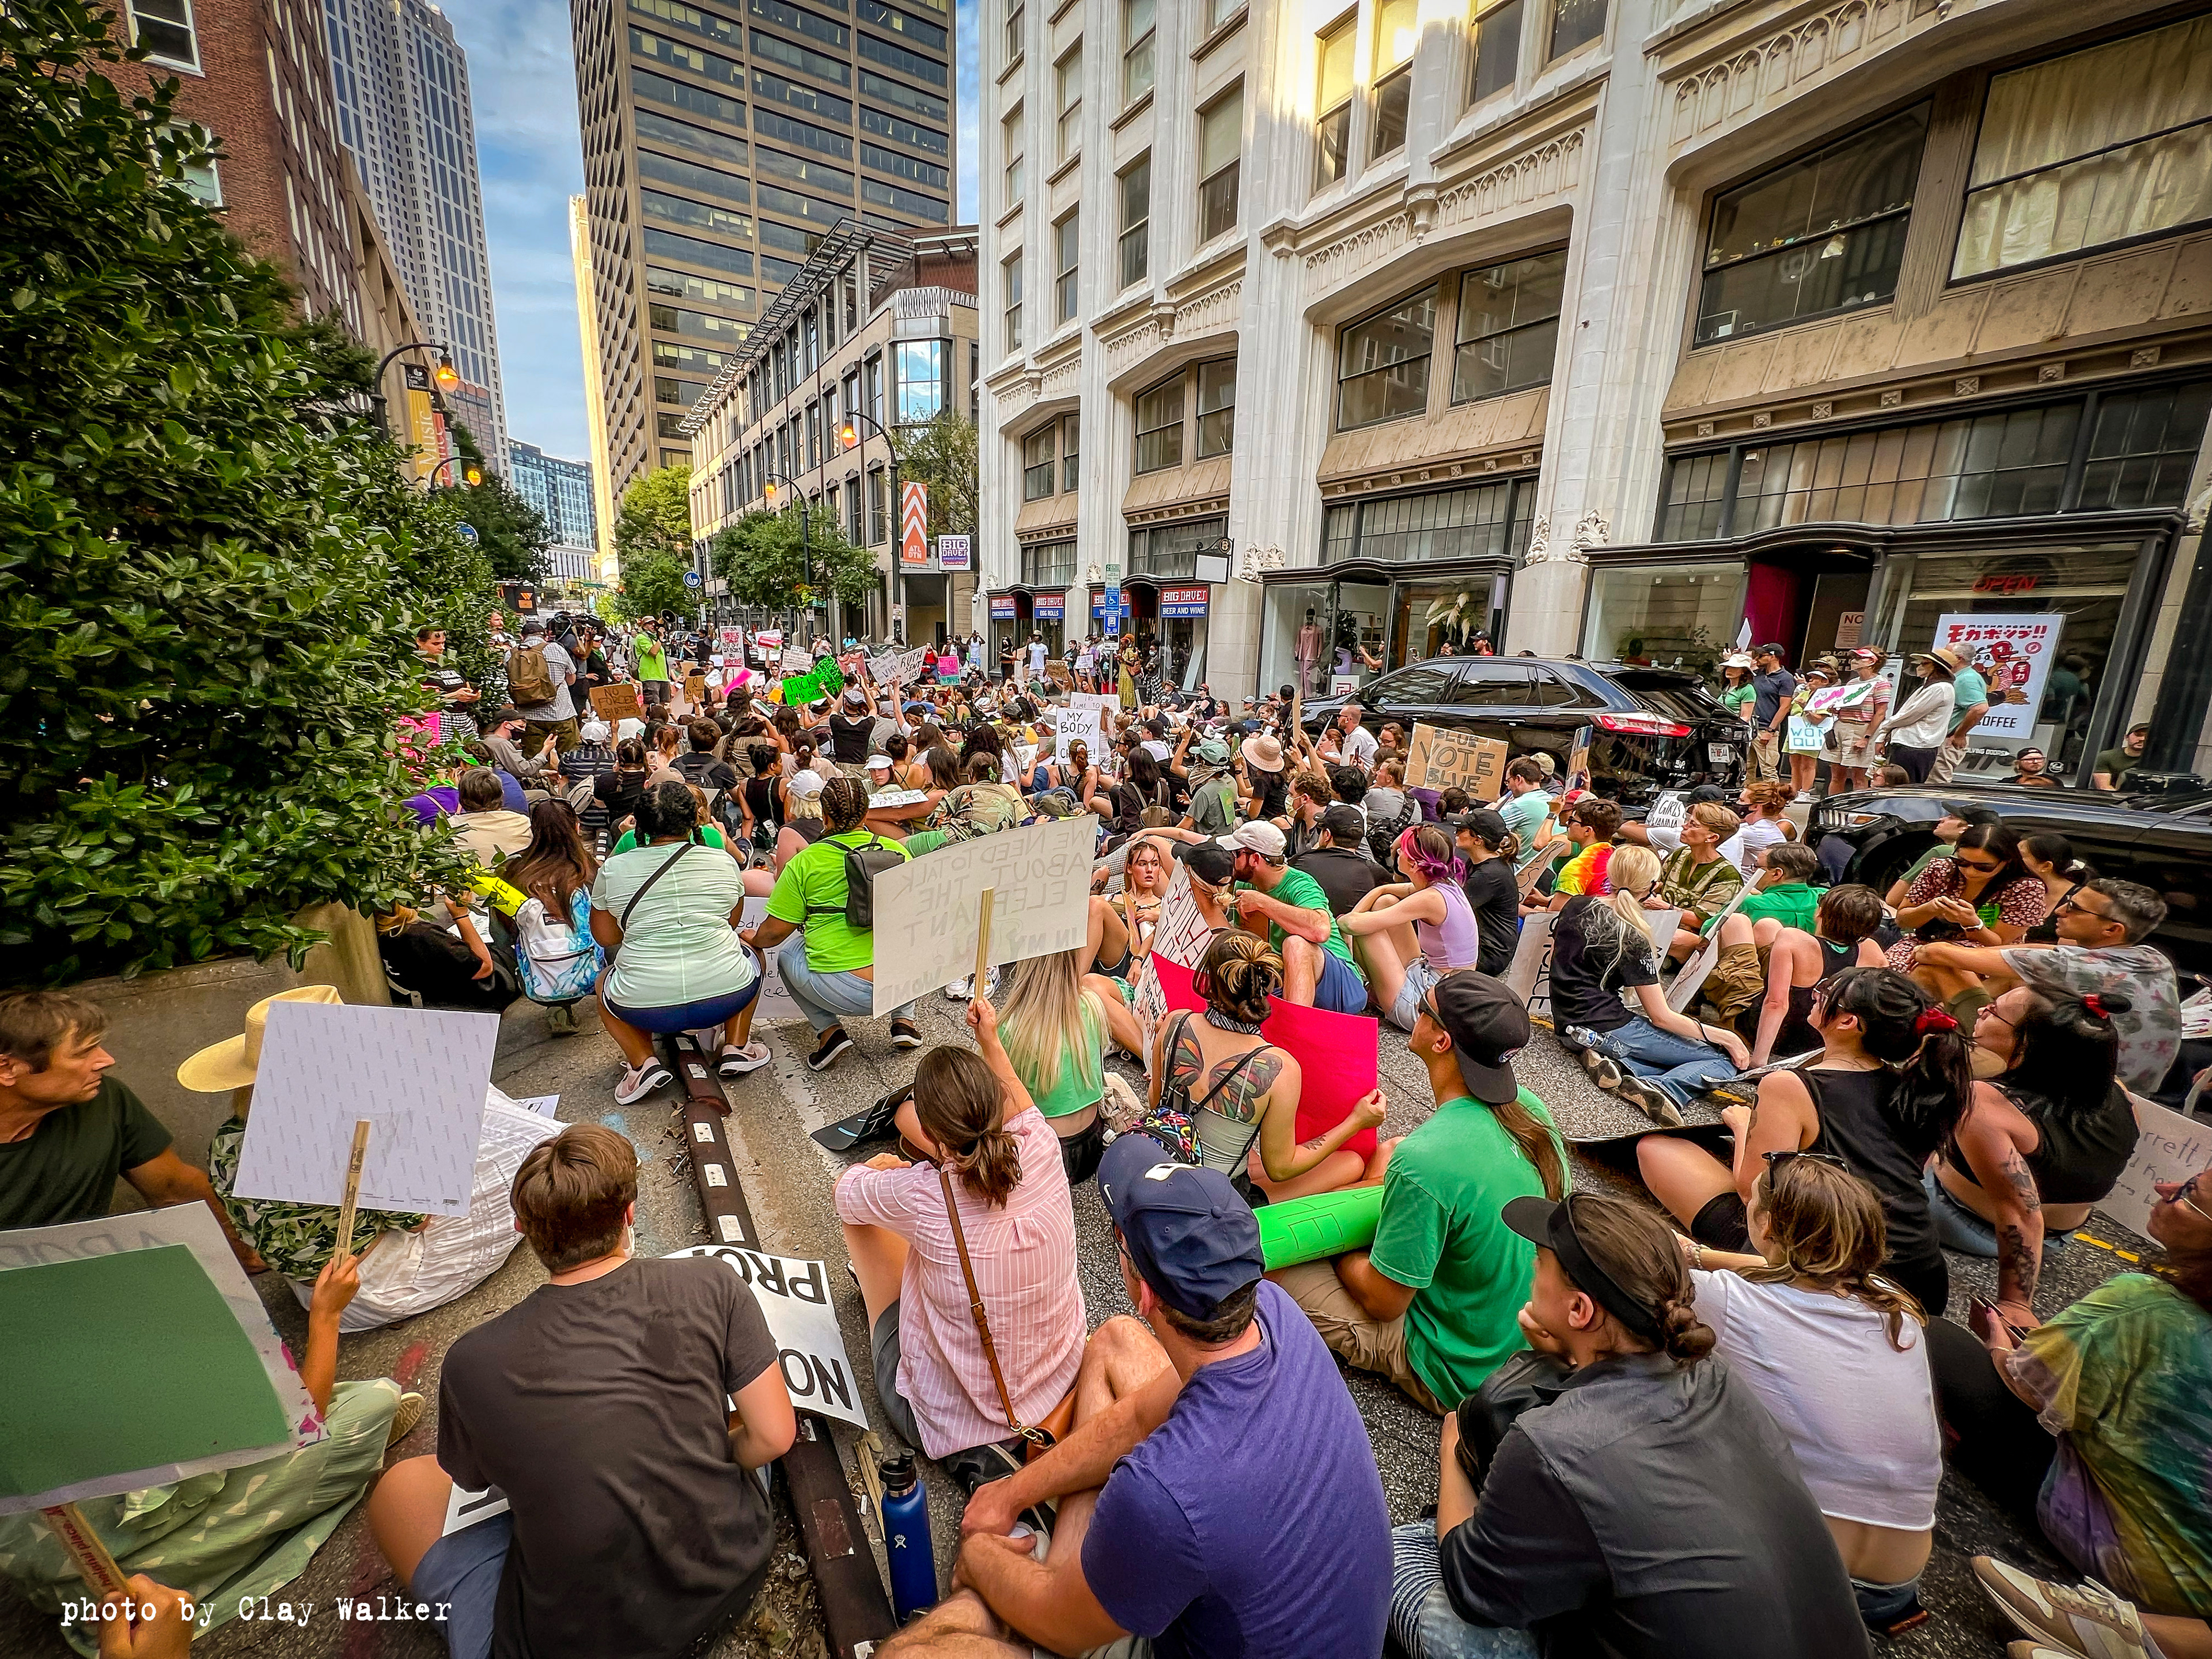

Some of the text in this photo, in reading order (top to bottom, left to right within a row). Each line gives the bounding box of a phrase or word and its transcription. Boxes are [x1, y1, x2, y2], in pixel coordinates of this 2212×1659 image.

[419, 411, 437, 465] Music
[941, 540, 967, 550] BIG
[1971, 576, 2038, 592] OPEN
[1036, 597, 1047, 605] BIG
[1163, 592, 1179, 602] BIG
[1177, 607, 1189, 615] AND
[1190, 606, 1205, 615] WINE
[900, 649, 923, 669] RUTH
[904, 661, 922, 674] SENT
[788, 678, 817, 692] FUCK
[604, 687, 619, 698] NO
[789, 692, 805, 701] THIS
[598, 695, 637, 709] FORCED
[603, 706, 637, 718] BIRTHS
[1067, 712, 1083, 722] MY
[1419, 741, 1495, 777] VOTE
[1426, 767, 1481, 794] BLUE
[1658, 800, 1681, 817] GIRLS
